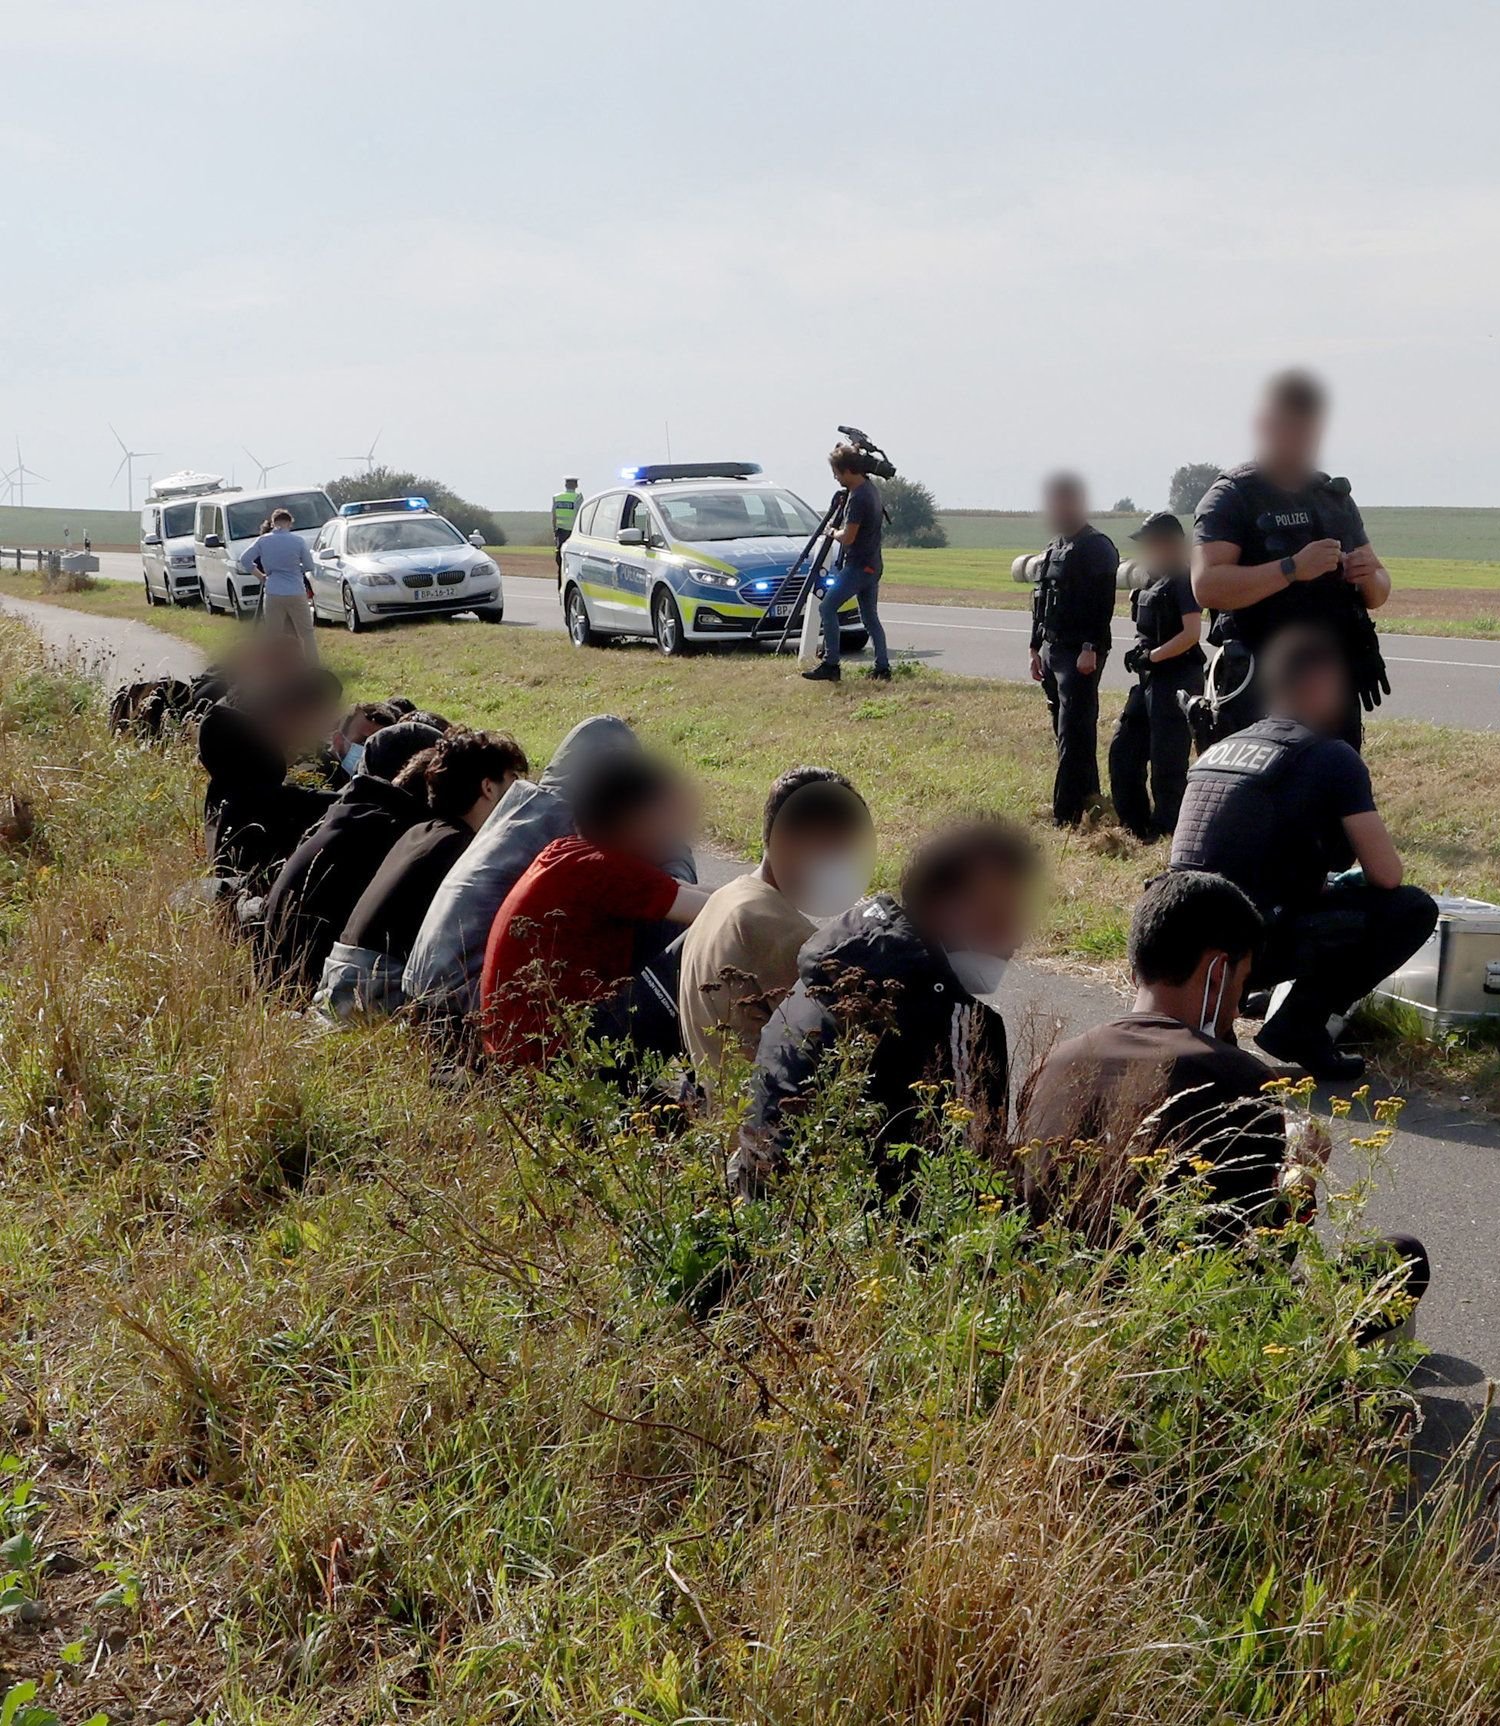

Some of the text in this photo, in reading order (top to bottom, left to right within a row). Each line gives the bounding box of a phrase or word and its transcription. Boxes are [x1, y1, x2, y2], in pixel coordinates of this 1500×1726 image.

[1275, 511, 1309, 526] POLIZEI
[776, 605, 788, 615] BP
[1196, 743, 1279, 771] POLIZEI
